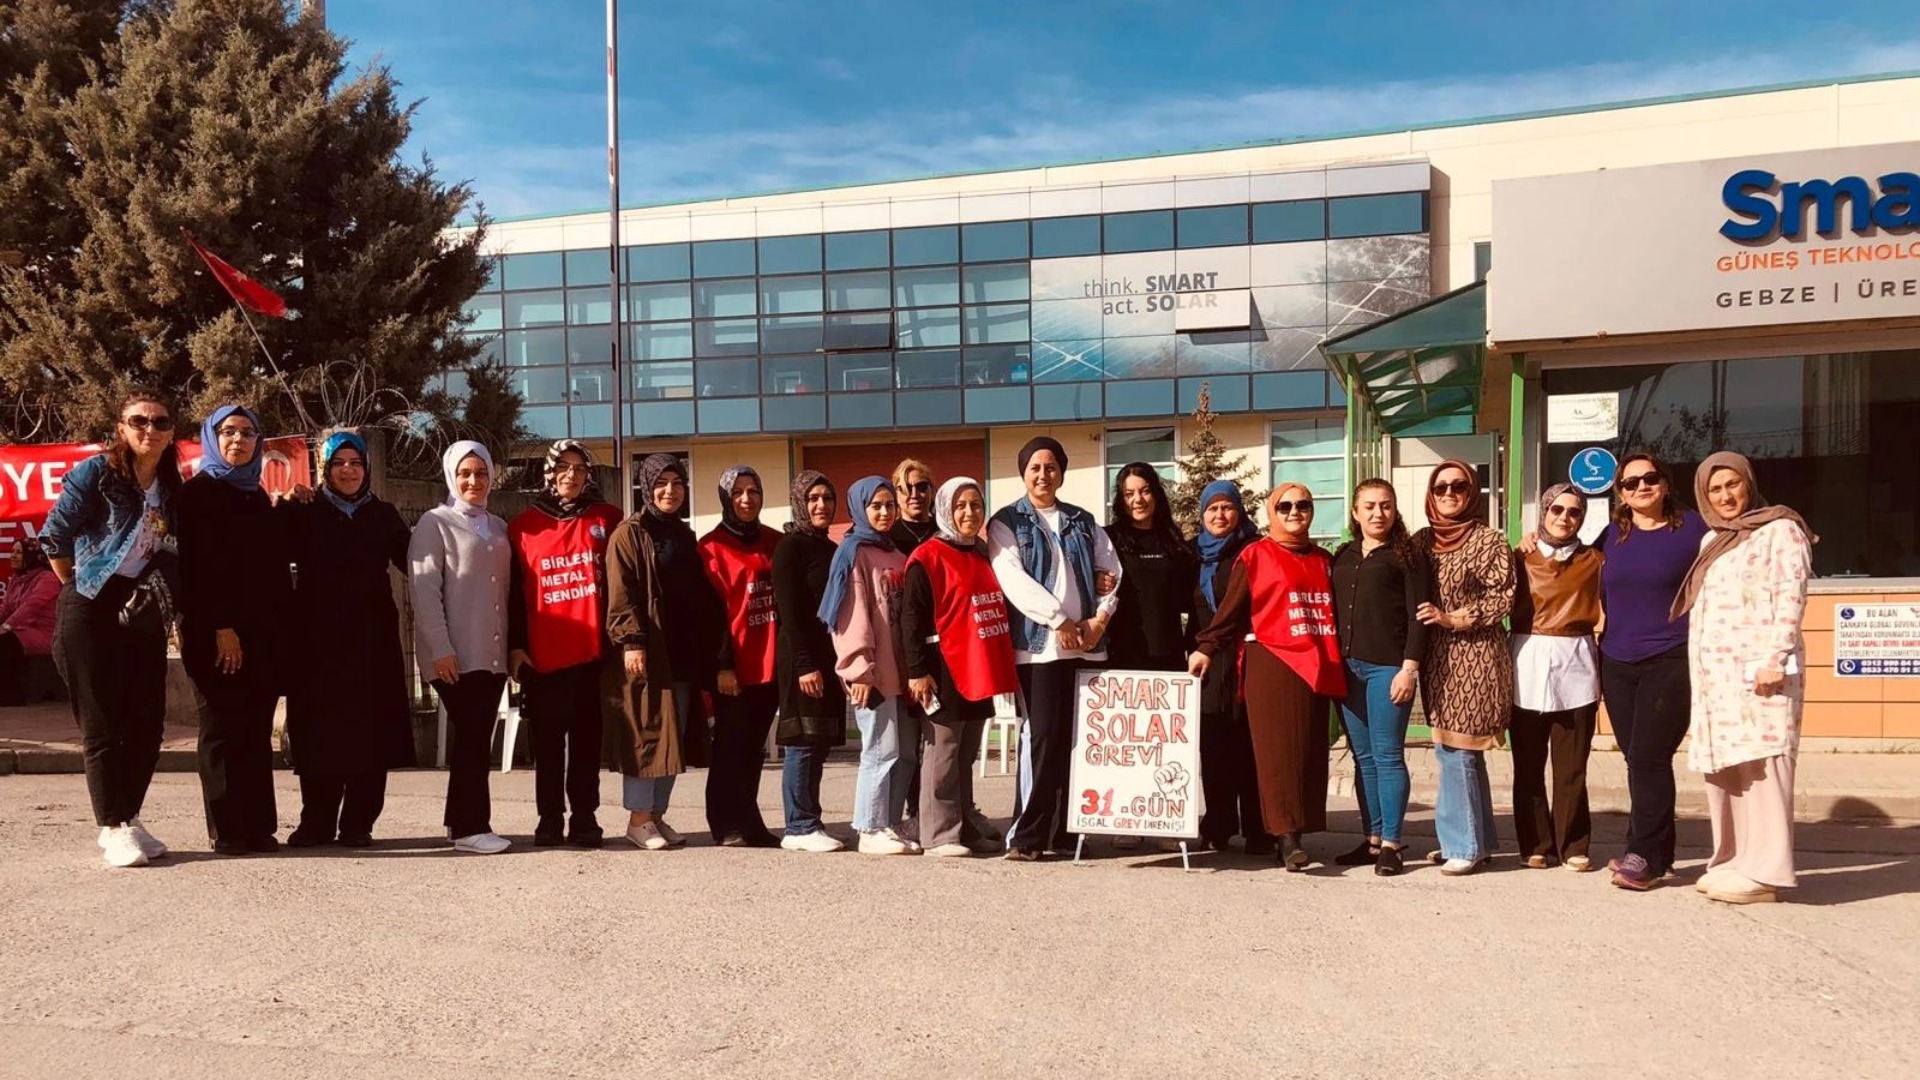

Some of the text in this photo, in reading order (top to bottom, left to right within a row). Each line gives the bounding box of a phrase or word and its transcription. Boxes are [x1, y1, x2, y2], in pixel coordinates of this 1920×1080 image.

[1716, 251, 1800, 272] GÜNEŞ
[1084, 272, 1218, 297] think. SMART
[1716, 287, 1815, 308] GEBZE
[1858, 279, 1917, 298] ÜRE
[1103, 293, 1218, 315] act. SOLAR
[0, 461, 80, 501] YE
[541, 569, 587, 588] METAL
[747, 580, 772, 594] BİRL
[1288, 591, 1333, 606] BİRLEŞ
[748, 611, 777, 626] SEND
[1288, 607, 1326, 620] METAL
[1087, 676, 1193, 710] SMART
[1086, 711, 1188, 744] SOLAR
[1085, 743, 1163, 767] GREVİ
[1113, 816, 1141, 829] GREV
